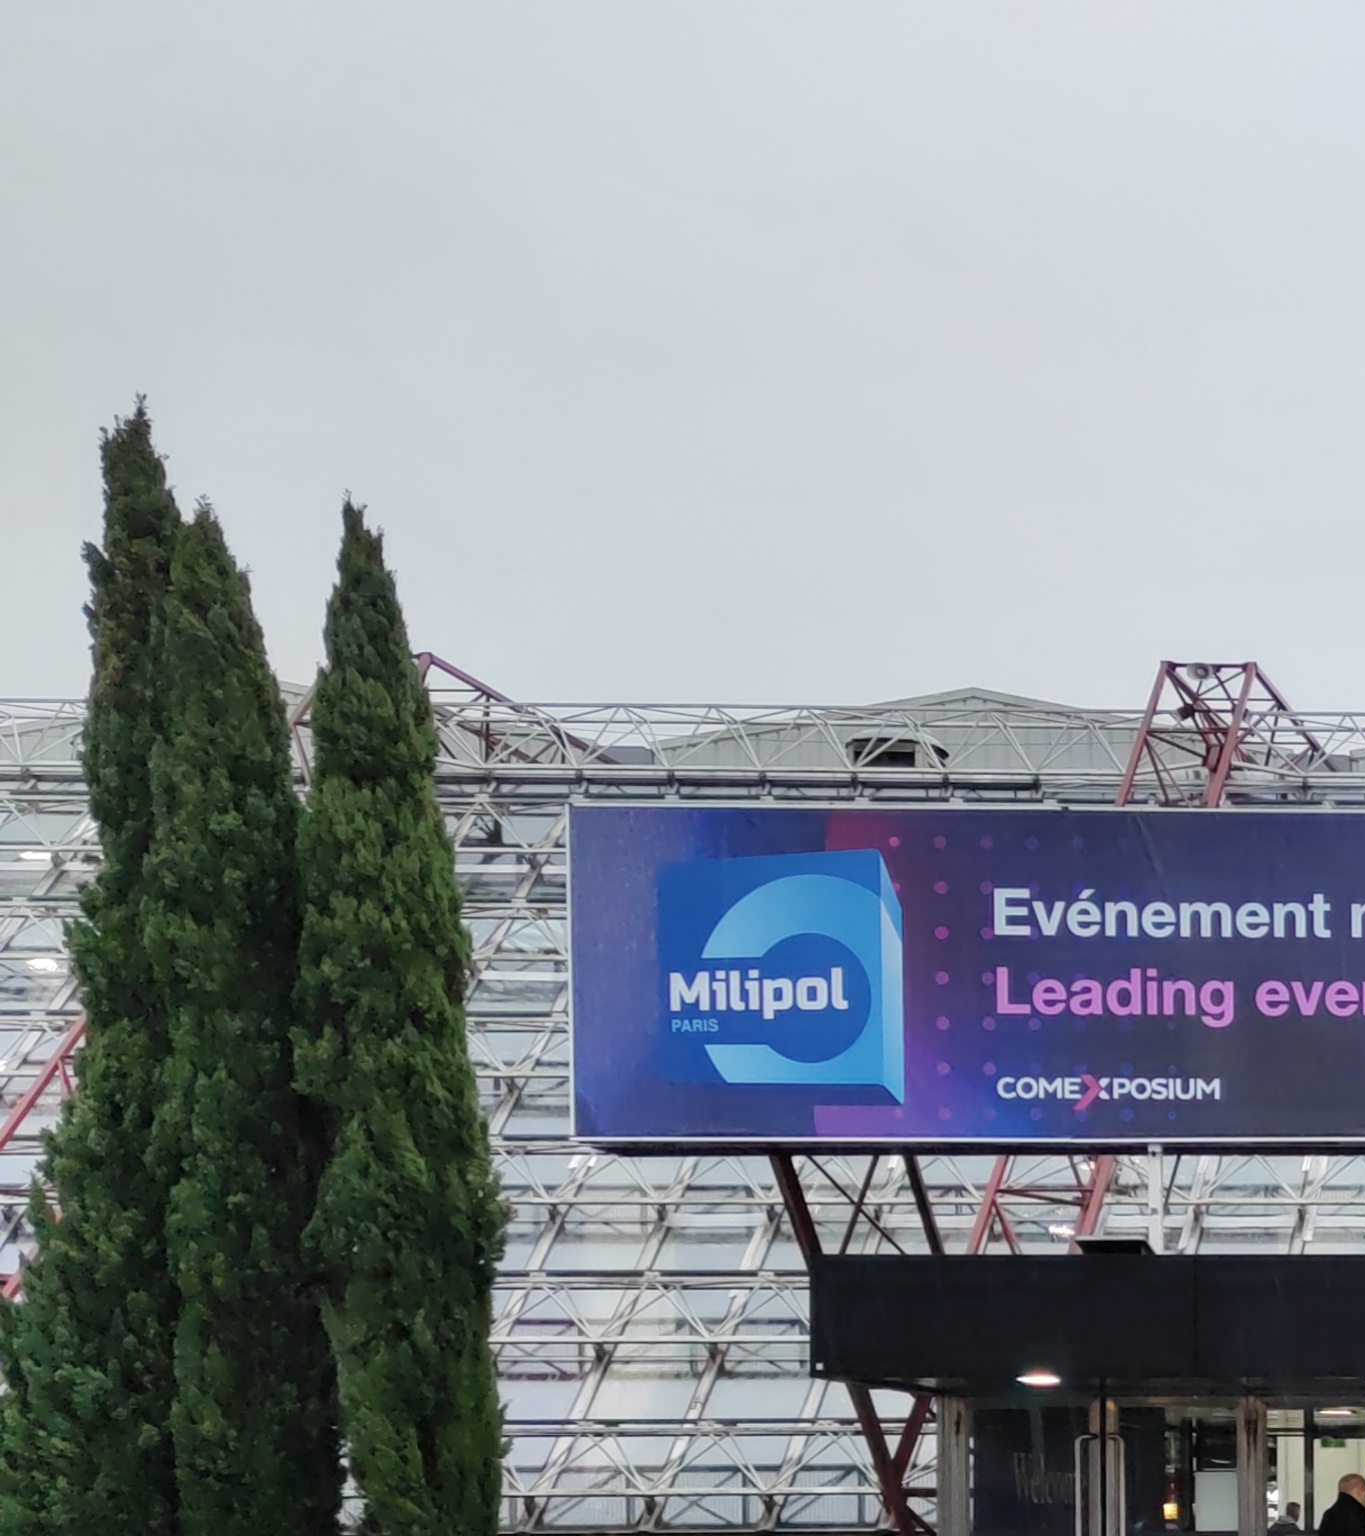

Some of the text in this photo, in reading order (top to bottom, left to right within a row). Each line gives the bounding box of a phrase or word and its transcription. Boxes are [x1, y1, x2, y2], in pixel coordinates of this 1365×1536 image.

[993, 888, 1332, 940] Evénement
[669, 967, 849, 1019] Milipol
[995, 966, 1234, 1028] Leading
[671, 1019, 719, 1033] PARIS
[996, 1074, 1221, 1110] COMEXPOSIUM
